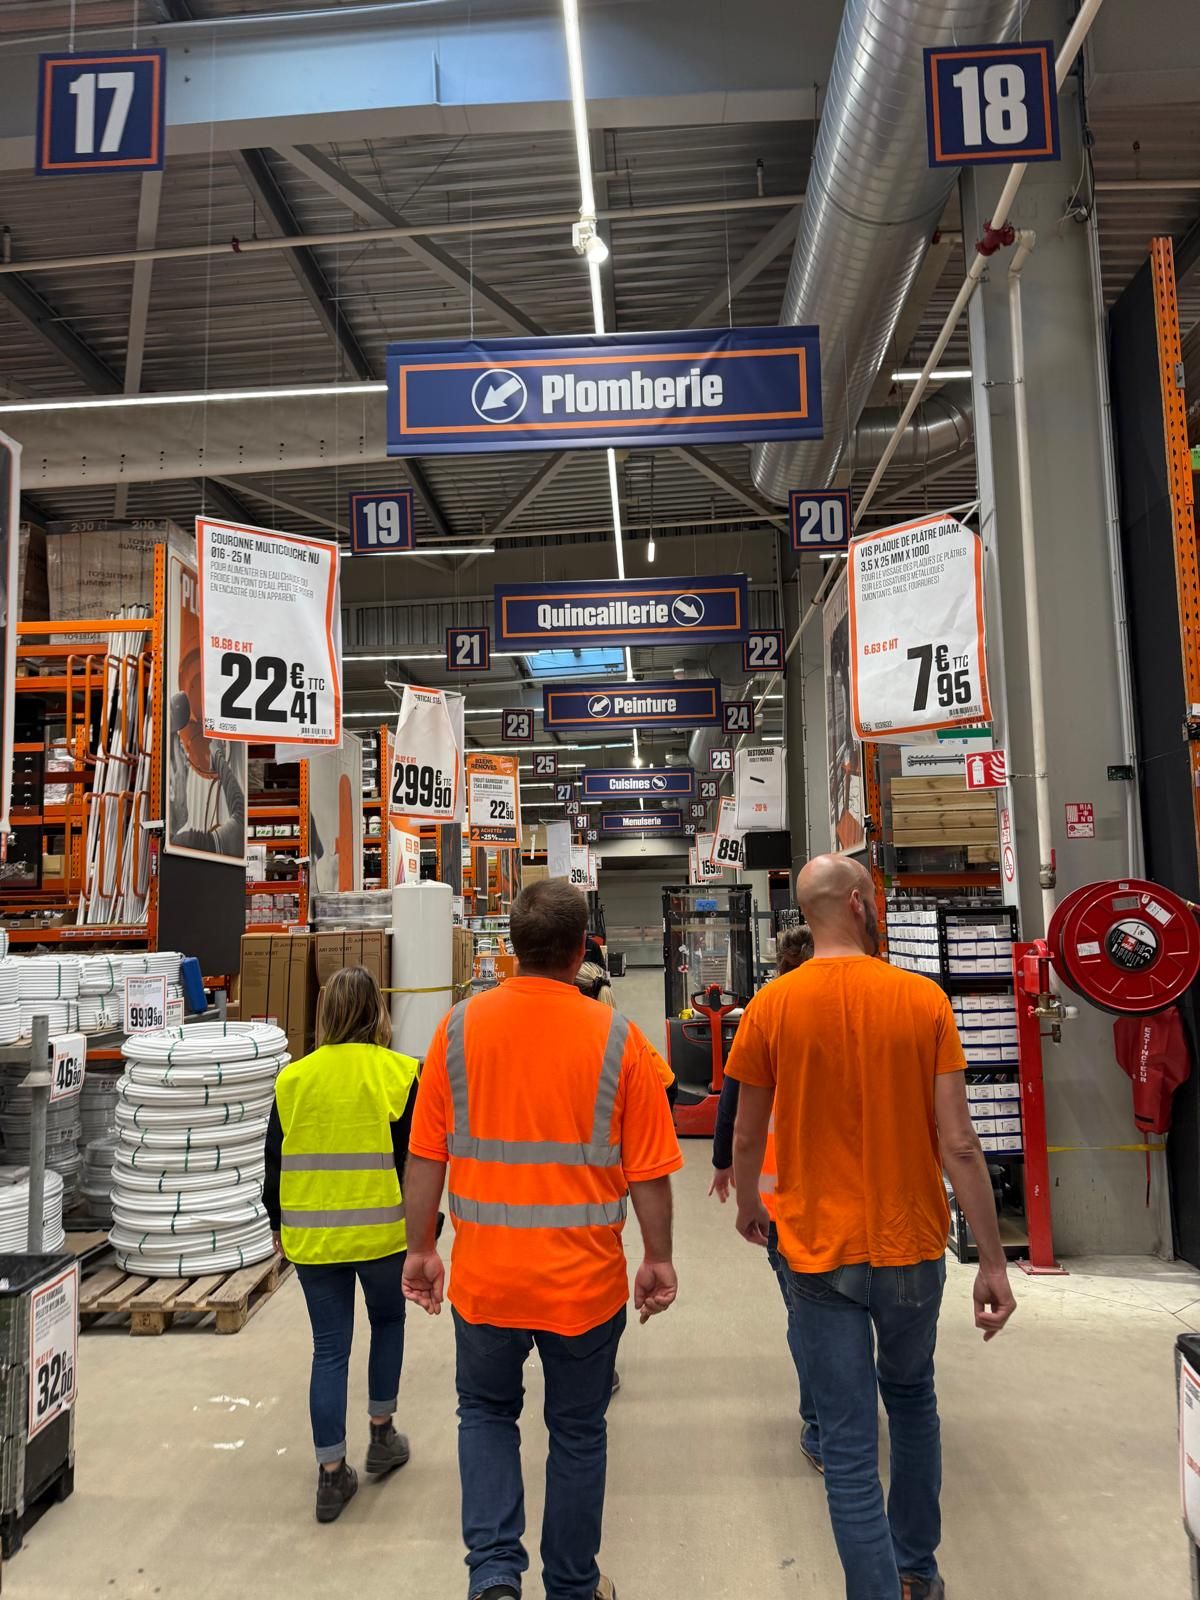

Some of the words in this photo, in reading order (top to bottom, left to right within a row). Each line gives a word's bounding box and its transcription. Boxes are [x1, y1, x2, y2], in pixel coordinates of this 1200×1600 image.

[69, 71, 135, 154] 17
[952, 63, 1028, 146] 18
[542, 367, 723, 414] Plomberie
[363, 501, 400, 545] 19
[799, 500, 844, 542] 20
[211, 532, 254, 551] COURONNE
[255, 540, 307, 562] MULTICOUCHE
[308, 551, 320, 564] NU
[860, 544, 873, 558] VIS
[874, 538, 900, 555] PLAQUE
[901, 536, 910, 548] DE
[911, 527, 937, 545] PLÂTRE
[938, 523, 962, 537] DIAM.
[231, 550, 242, 563] 25
[243, 552, 251, 565] M
[873, 557, 880, 569] X
[880, 554, 890, 568] 25
[890, 550, 904, 565] MM
[905, 549, 911, 561] X
[911, 543, 930, 558] 1000
[210, 561, 226, 571] POUR
[227, 563, 259, 577] ALIMENTER
[268, 570, 280, 580] EAU
[861, 572, 875, 583] POUR
[875, 570, 882, 579] LE
[882, 564, 902, 578] VISSAGE
[913, 555, 936, 570] PLAQUES
[936, 553, 943, 563] DE
[210, 582, 218, 592] EN
[266, 591, 297, 602] APPARENT
[240, 576, 258, 588] POINT
[861, 582, 873, 592] SUR
[873, 579, 882, 589] LES
[882, 572, 910, 588] OSSATURES
[537, 600, 669, 630] Quincaillerie
[210, 636, 233, 650] 18.68
[234, 641, 241, 651] €
[242, 641, 253, 653] HT
[456, 634, 480, 665] 21
[749, 636, 778, 666] 22
[864, 642, 881, 655] 6.63
[882, 642, 887, 651] €
[889, 638, 899, 649] HT
[934, 644, 949, 672] €
[953, 655, 969, 669] TTC
[290, 663, 305, 689] €
[308, 677, 325, 691] TTC
[907, 643, 933, 712] 7
[220, 652, 287, 723] 22
[937, 669, 972, 707] 95
[291, 690, 317, 725] 41
[614, 696, 677, 714] Peinture
[506, 714, 529, 737] 23
[727, 706, 750, 730] 24
[536, 756, 554, 774] 25
[712, 751, 731, 769] 26
[392, 762, 434, 807] 299
[435, 770, 442, 786] €
[609, 777, 650, 790] Cuisines
[434, 787, 451, 808] 90
[557, 785, 571, 800] 27
[701, 782, 716, 797] 28
[490, 800, 505, 819] 22
[505, 810, 514, 820] 90
[567, 803, 579, 814] 29
[691, 804, 704, 817] 30
[577, 816, 587, 828] 31
[622, 816, 661, 826] Menuiserie
[685, 824, 695, 834] 32
[472, 828, 480, 840] 2
[587, 831, 597, 840] 33
[717, 838, 739, 861] 89
[571, 869, 582, 883] 39
[702, 860, 715, 875] 159
[1140, 1026, 1152, 1084] EXTINCTEUR
[56, 1057, 73, 1089] 46
[72, 1069, 81, 1086] 90
[37, 1354, 61, 1416] 32
[60, 1367, 72, 1397] 00
